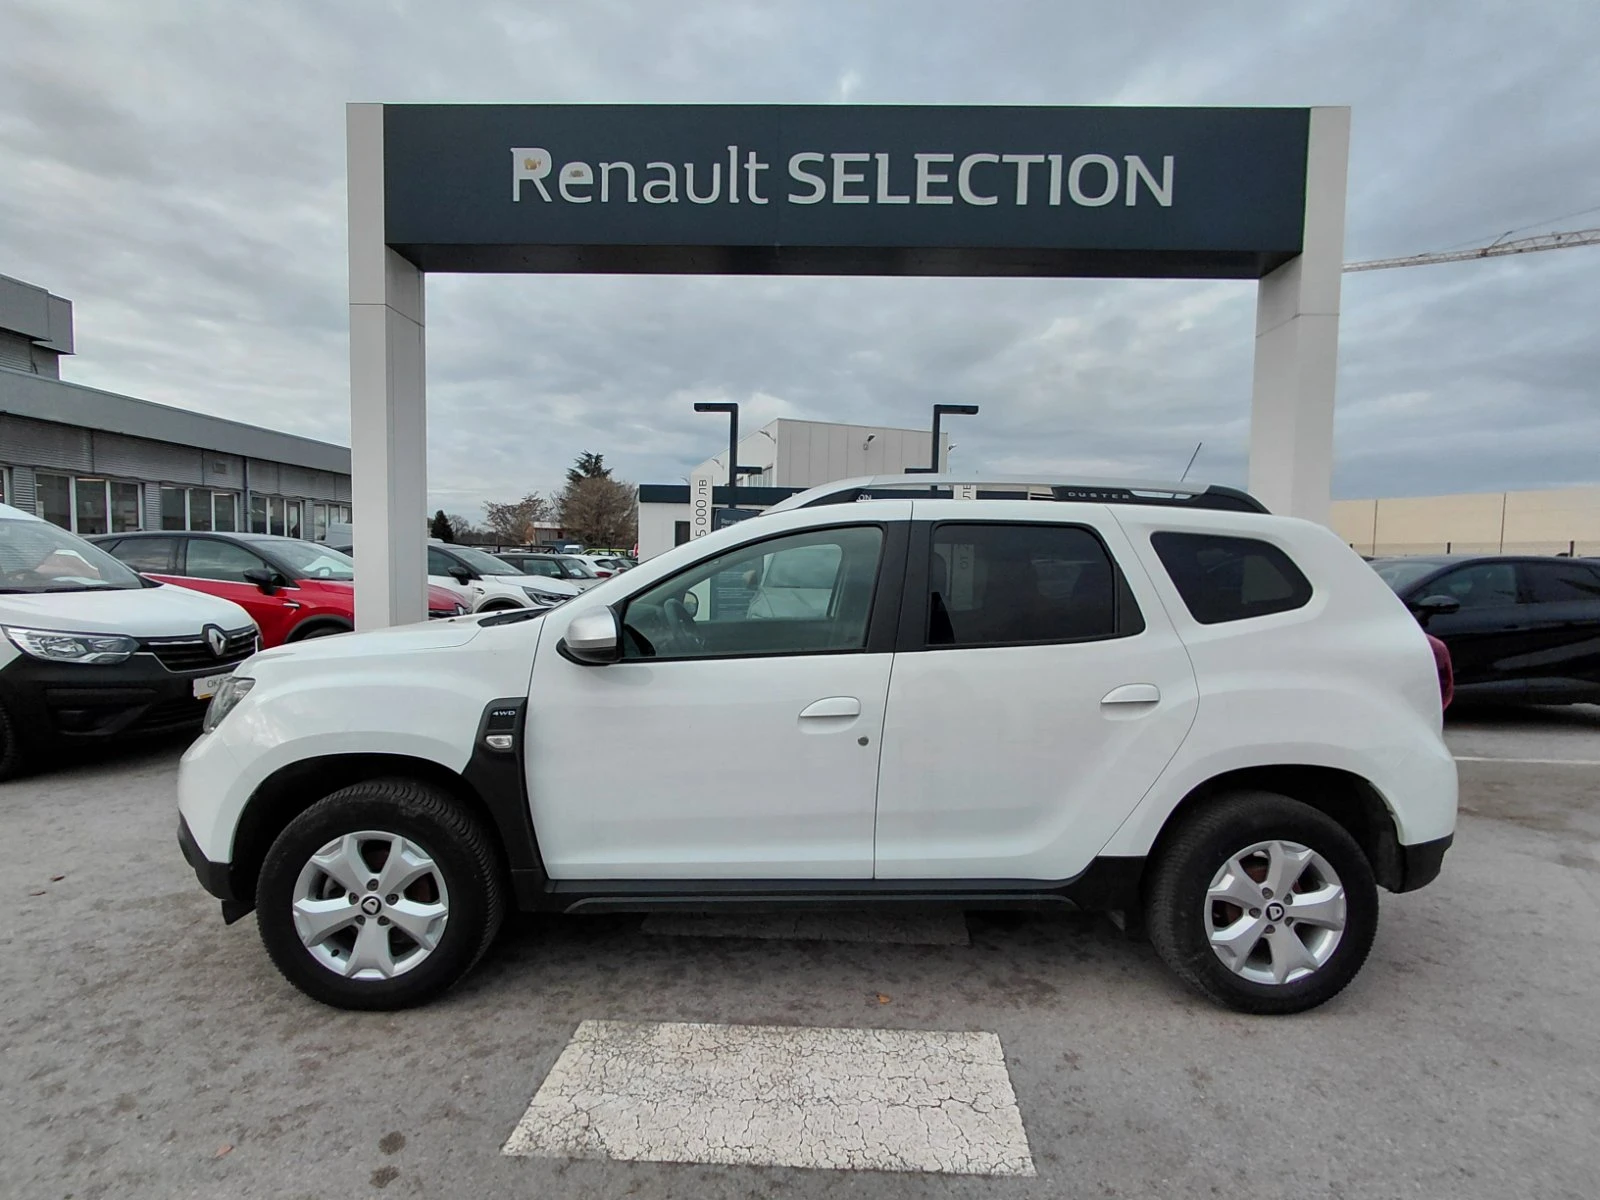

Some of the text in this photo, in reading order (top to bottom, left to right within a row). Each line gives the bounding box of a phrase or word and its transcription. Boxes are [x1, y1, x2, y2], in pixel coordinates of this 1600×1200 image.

[510, 145, 1174, 207] Renault SELECTION
[1067, 491, 1130, 499] DUSTER
[695, 499, 707, 526] 000
